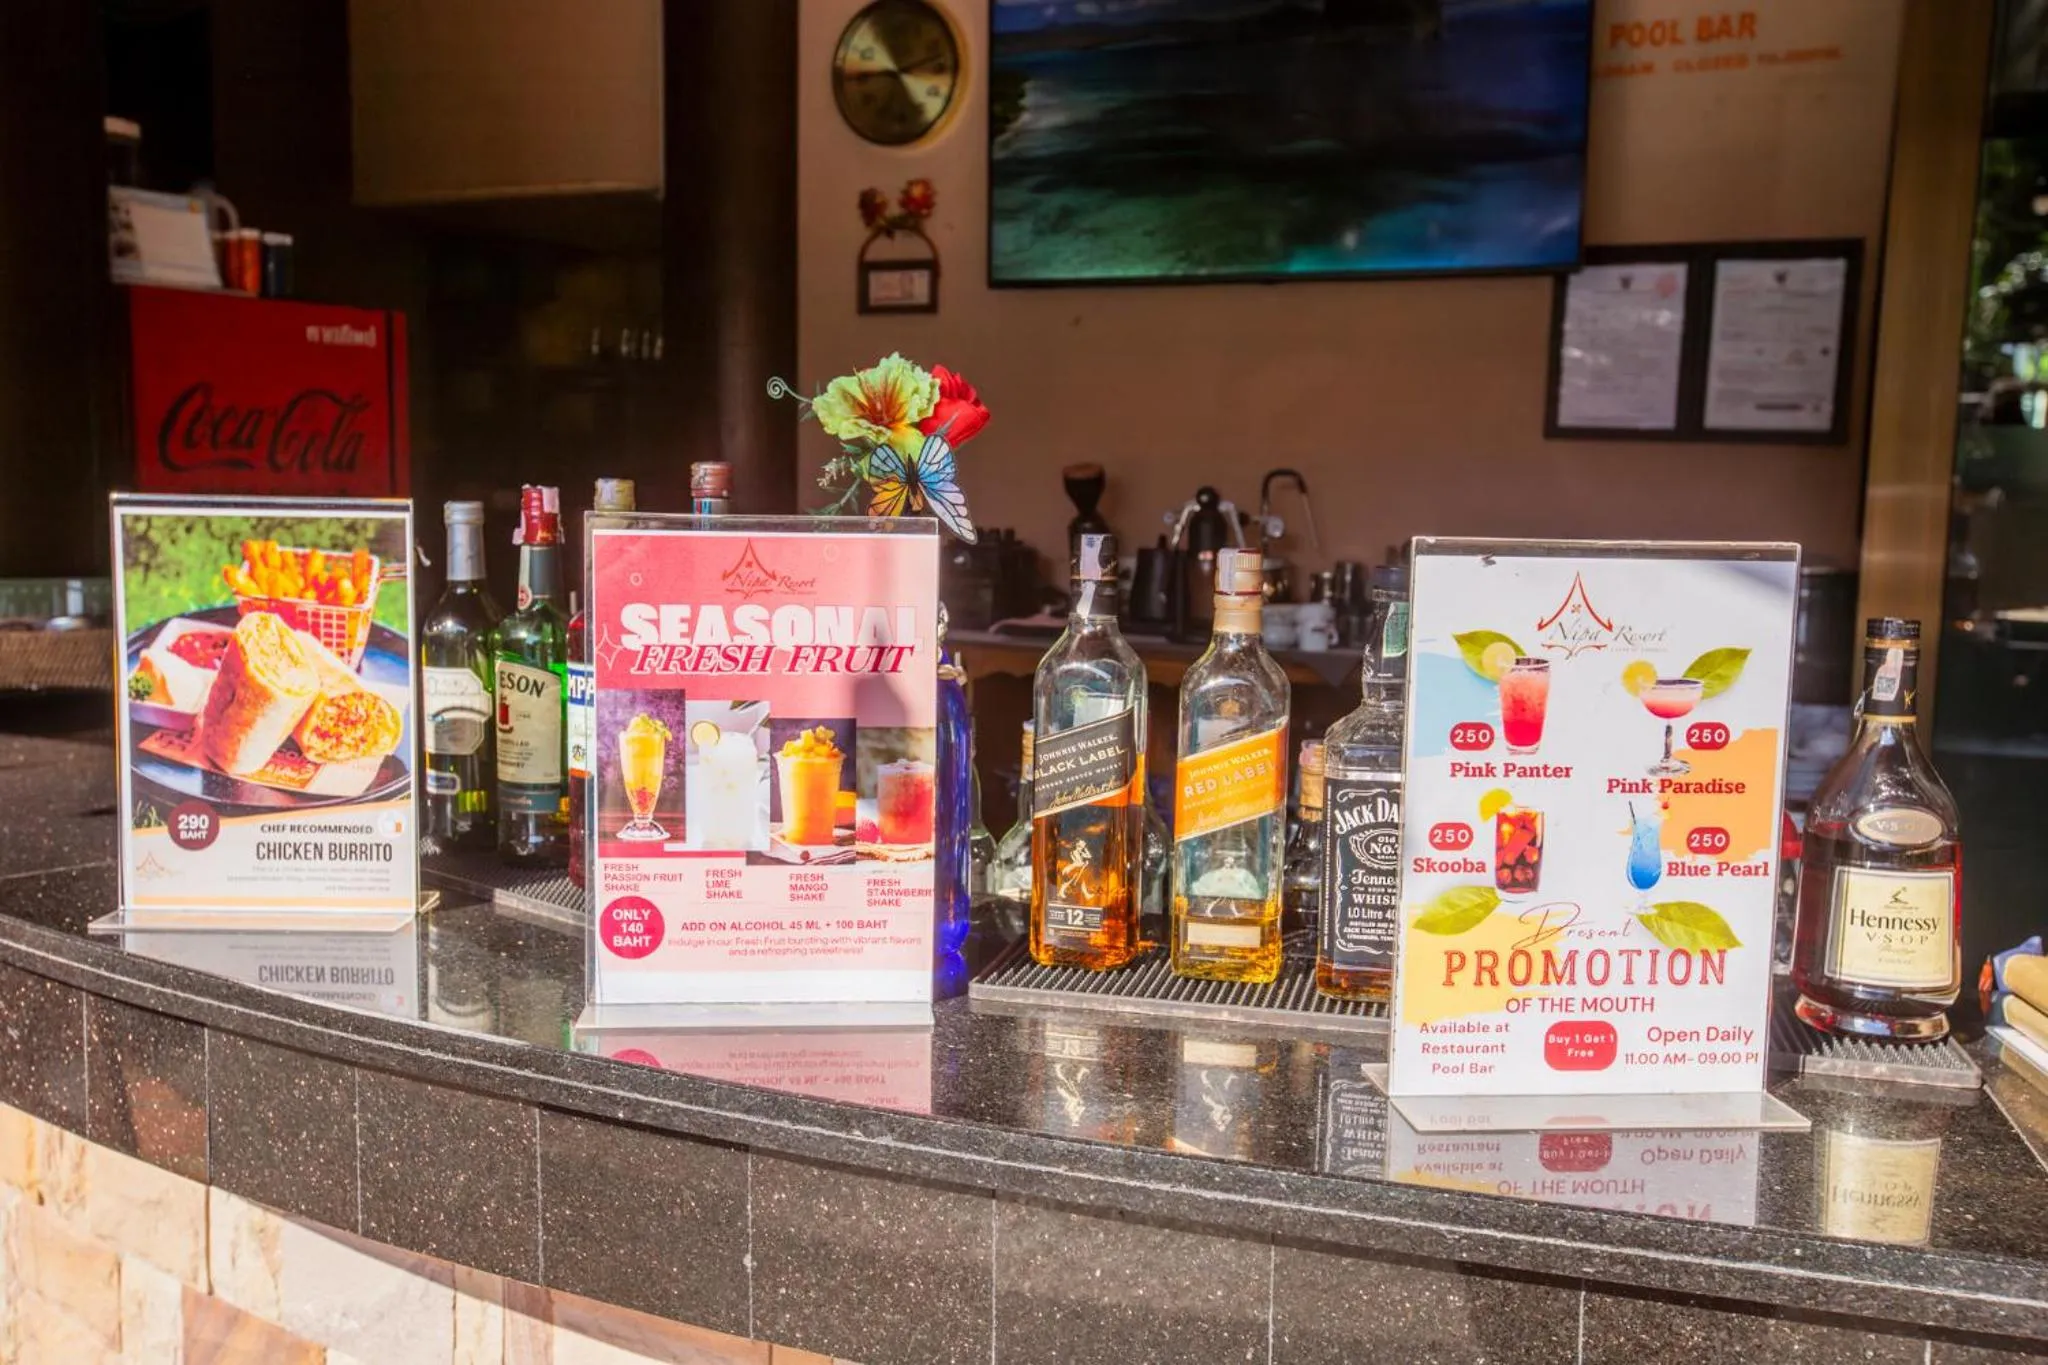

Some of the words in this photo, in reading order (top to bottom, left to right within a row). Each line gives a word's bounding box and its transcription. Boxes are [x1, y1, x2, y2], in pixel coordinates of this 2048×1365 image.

[1609, 19, 1684, 49] POOL
[1696, 12, 1758, 42] BAR
[620, 602, 924, 651] SEASONAL
[1613, 625, 1667, 646] Resort
[632, 645, 774, 674] FRESH
[786, 645, 914, 675] FRUIT
[1454, 729, 1490, 743] 250
[1690, 729, 1726, 743] 250
[1039, 745, 1077, 766] JOHNNIE
[1079, 746, 1126, 767] LABEL
[1450, 761, 1497, 778] Pink
[1504, 762, 1574, 778] Panter
[1184, 778, 1217, 799] RED
[1607, 777, 1653, 794] Pink
[1659, 777, 1746, 794] Paradise
[178, 814, 210, 830] 290
[1334, 803, 1376, 835] JACK
[180, 830, 207, 840] BAHT
[261, 823, 286, 835] CHEF
[290, 824, 374, 836] RECOMMENDED
[1433, 829, 1470, 843] 250
[1691, 833, 1727, 847] 250
[256, 842, 324, 861] CHICKEN
[329, 843, 393, 863] BURRITO
[604, 864, 639, 872] FRESH
[1413, 857, 1487, 873] Skooba
[1667, 860, 1712, 877] Blue
[1717, 861, 1771, 877] Pearl
[604, 873, 651, 881] PASSION
[654, 873, 683, 882] FRUIT
[706, 869, 743, 879] FRESH
[789, 873, 825, 883] FRESH
[604, 883, 640, 892] SHAKE
[706, 880, 731, 889] LIME
[789, 883, 829, 892] MANGO
[867, 878, 902, 887] FRESH
[706, 890, 744, 899] SHAKE
[789, 893, 826, 903] SHAKE
[867, 899, 902, 908] SHAKE
[612, 908, 652, 921] ONLY
[1066, 908, 1084, 926] 12
[1850, 907, 1940, 934] Hennessy
[621, 922, 644, 934] 140
[681, 922, 707, 931] ADD
[709, 921, 727, 931] ON
[729, 920, 786, 931] ALCOHOL
[789, 920, 802, 930] 45
[805, 919, 821, 930] ML
[836, 919, 854, 930] 100
[857, 919, 889, 930] BAHT
[1510, 901, 1631, 950] Present
[613, 935, 653, 947] BAHT
[668, 937, 705, 949] Indulge
[736, 936, 762, 947] Fresh
[788, 936, 828, 947] bursting
[831, 936, 852, 946] with
[854, 936, 888, 946] vibrant
[758, 947, 807, 957] refreshing
[1443, 948, 1727, 986] PROMOTION
[1506, 997, 1533, 1013] OF
[1537, 997, 1575, 1013] THE
[1582, 996, 1655, 1013] MOUTH
[1420, 1022, 1490, 1034] Available
[1496, 1023, 1510, 1033] at
[1549, 1033, 1570, 1046] Buy
[1584, 1034, 1606, 1044] Get
[1648, 1026, 1700, 1046] Open
[1706, 1026, 1754, 1045] Daily
[1421, 1042, 1507, 1055] Restaurant
[1568, 1049, 1596, 1058] Free
[1625, 1053, 1659, 1065] 11.00
[1698, 1052, 1742, 1064] 09.00
[1432, 1063, 1465, 1075] Pool
[1470, 1063, 1496, 1075] Bar
